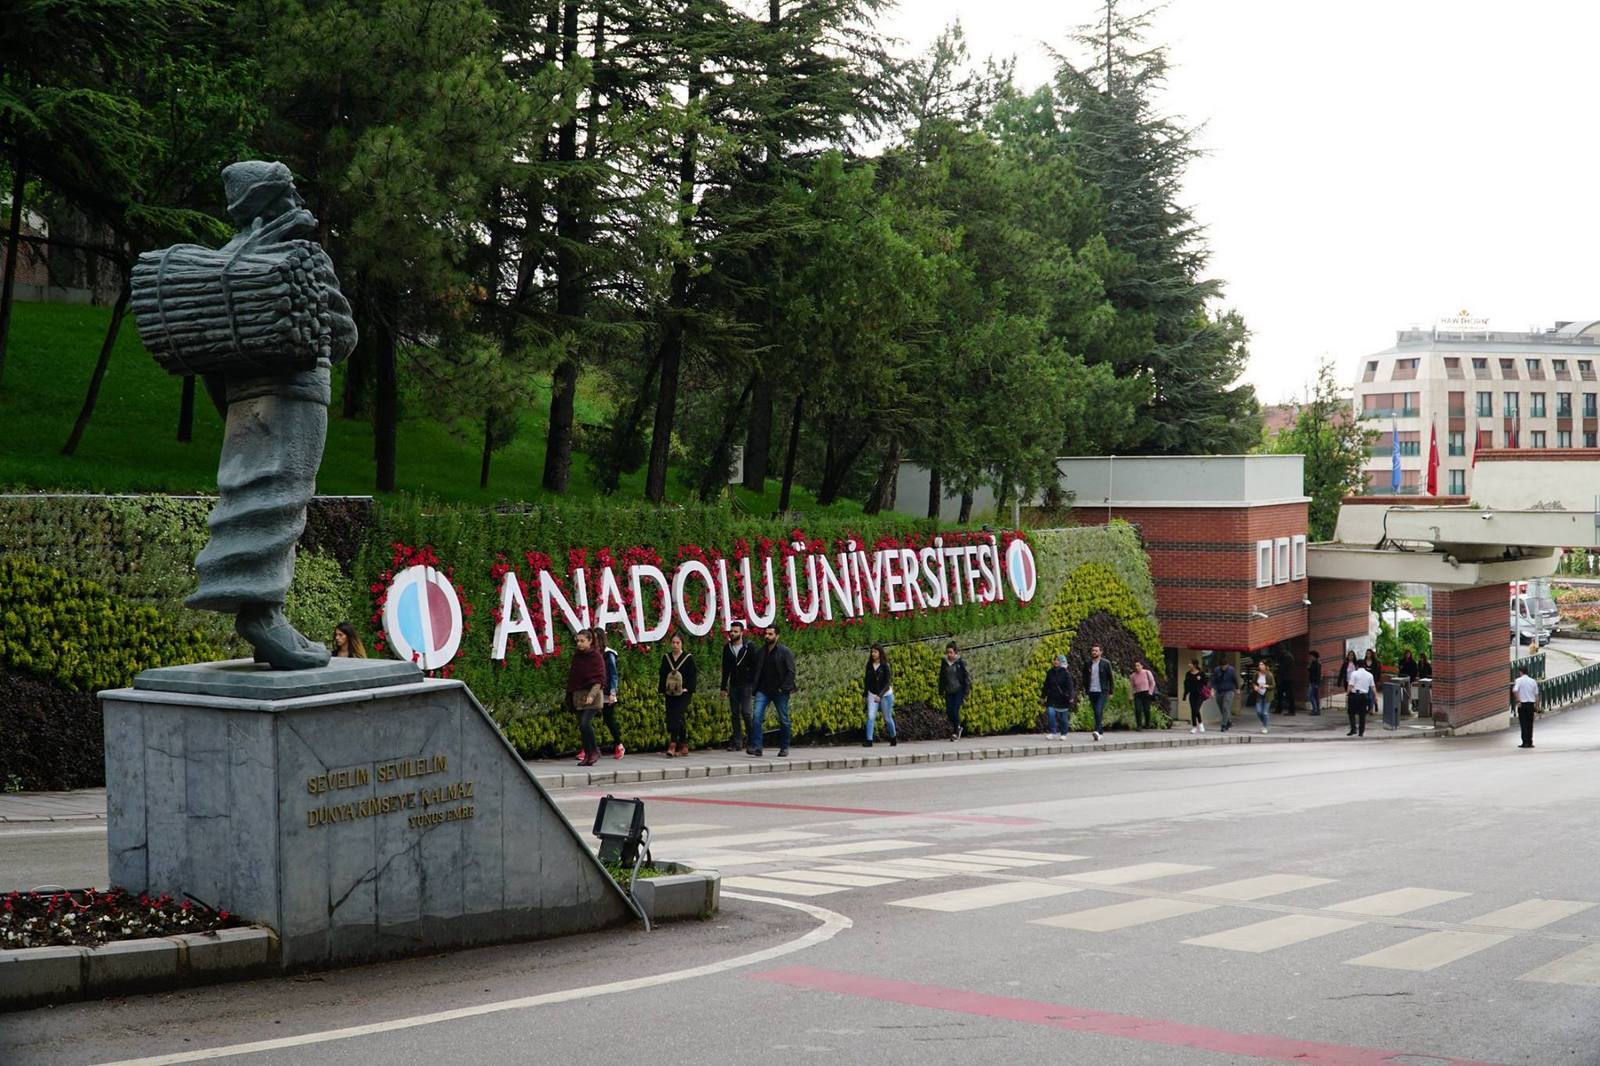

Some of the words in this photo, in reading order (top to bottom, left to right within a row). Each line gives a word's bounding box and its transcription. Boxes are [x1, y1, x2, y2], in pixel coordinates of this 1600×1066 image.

[491, 556, 777, 660] ANADOLU
[786, 534, 1004, 624] ÜNİVERSİTESİ
[420, 782, 474, 807] KALMAZ
[408, 811, 444, 829] YUNUS
[447, 806, 475, 822] EMRE
